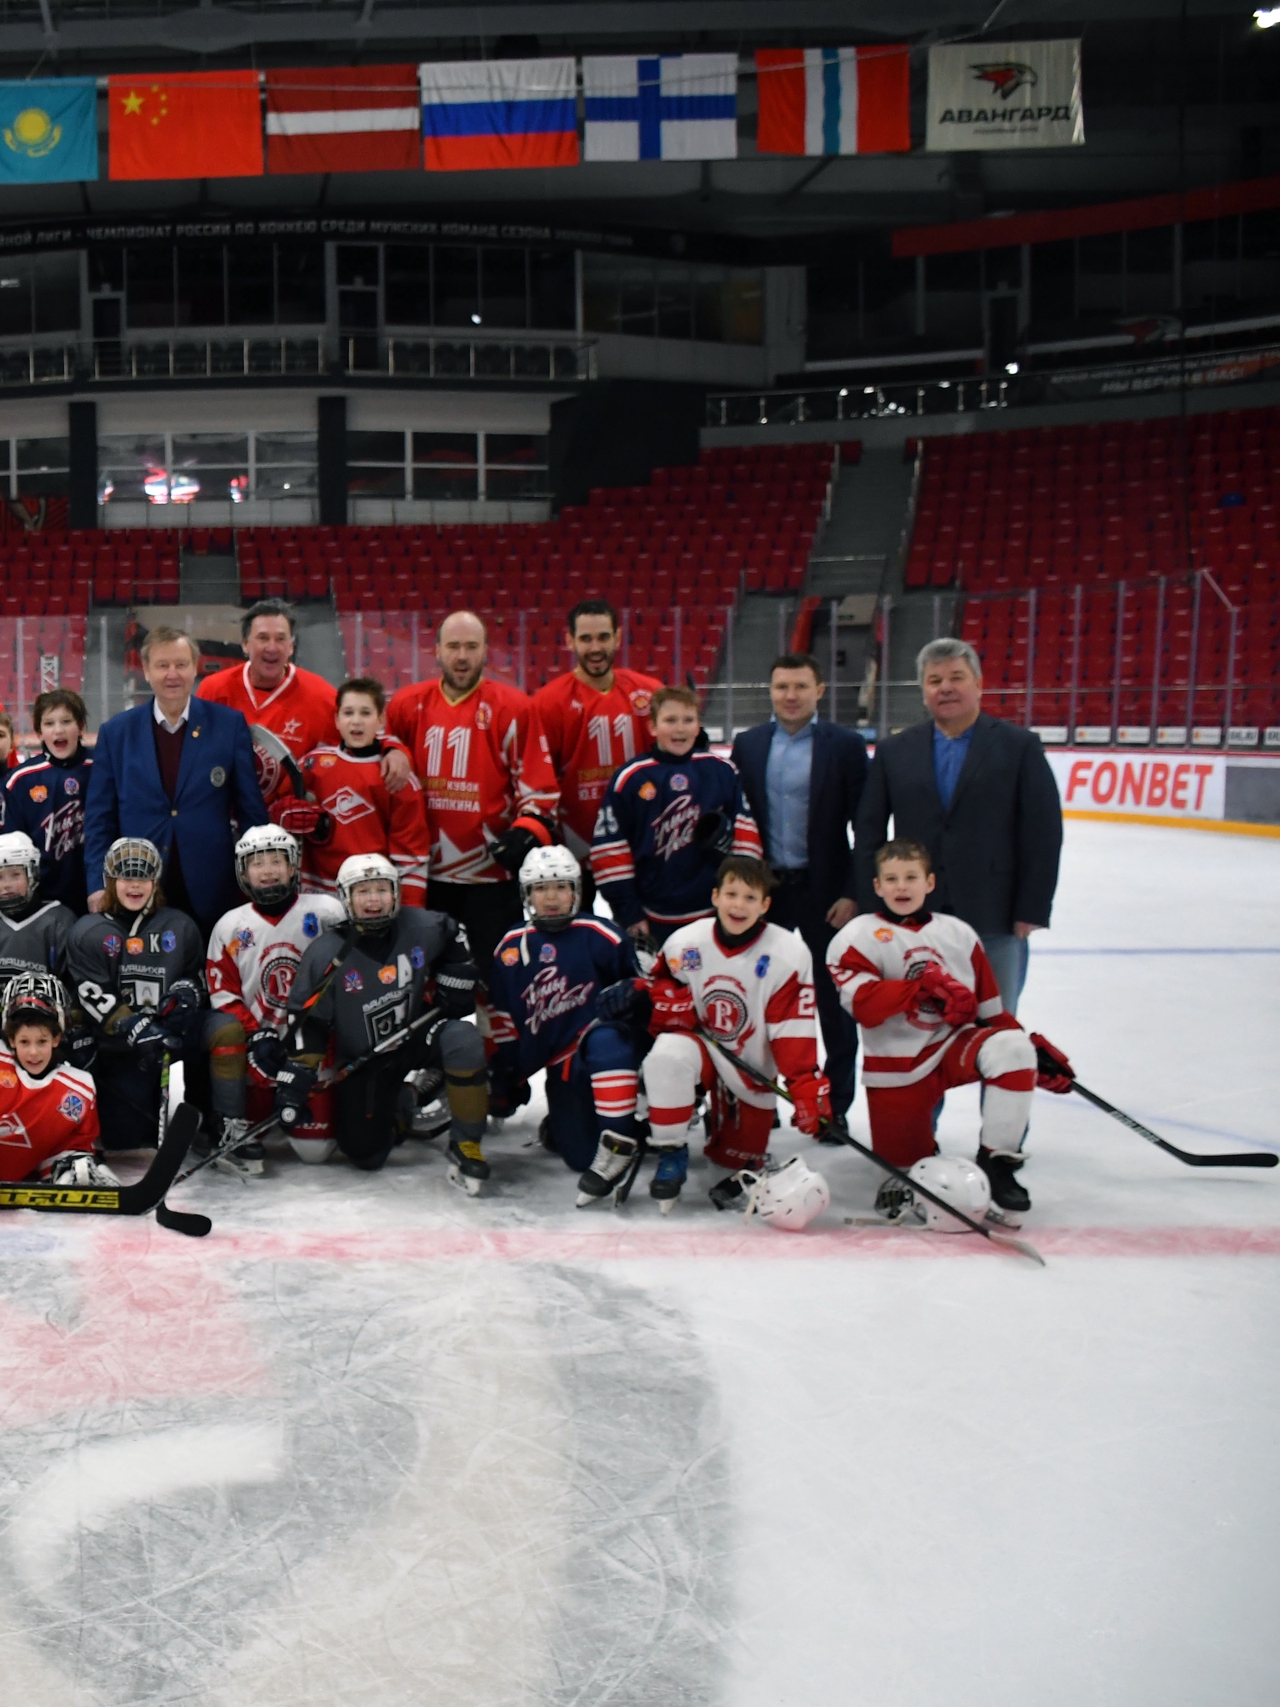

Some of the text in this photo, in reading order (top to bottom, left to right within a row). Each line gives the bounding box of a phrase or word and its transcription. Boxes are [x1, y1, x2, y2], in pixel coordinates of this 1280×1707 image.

[938, 106, 1070, 124] АВАНГАРД
[35, 229, 72, 245] ЛИГИ
[86, 225, 171, 241] ЧЕМПИОНАТ
[176, 222, 231, 238] РОССИИ
[235, 222, 255, 236] ПО
[258, 220, 318, 234] ХОККЕЮ
[321, 219, 366, 234] СРЕДИ
[370, 219, 437, 235] МУЖСКИХ
[424, 725, 472, 778] 11
[588, 713, 636, 767] 11
[446, 780, 479, 792] КУБОК
[1066, 760, 1214, 811] FONBET
[4, 1190, 120, 1208] TRUE
